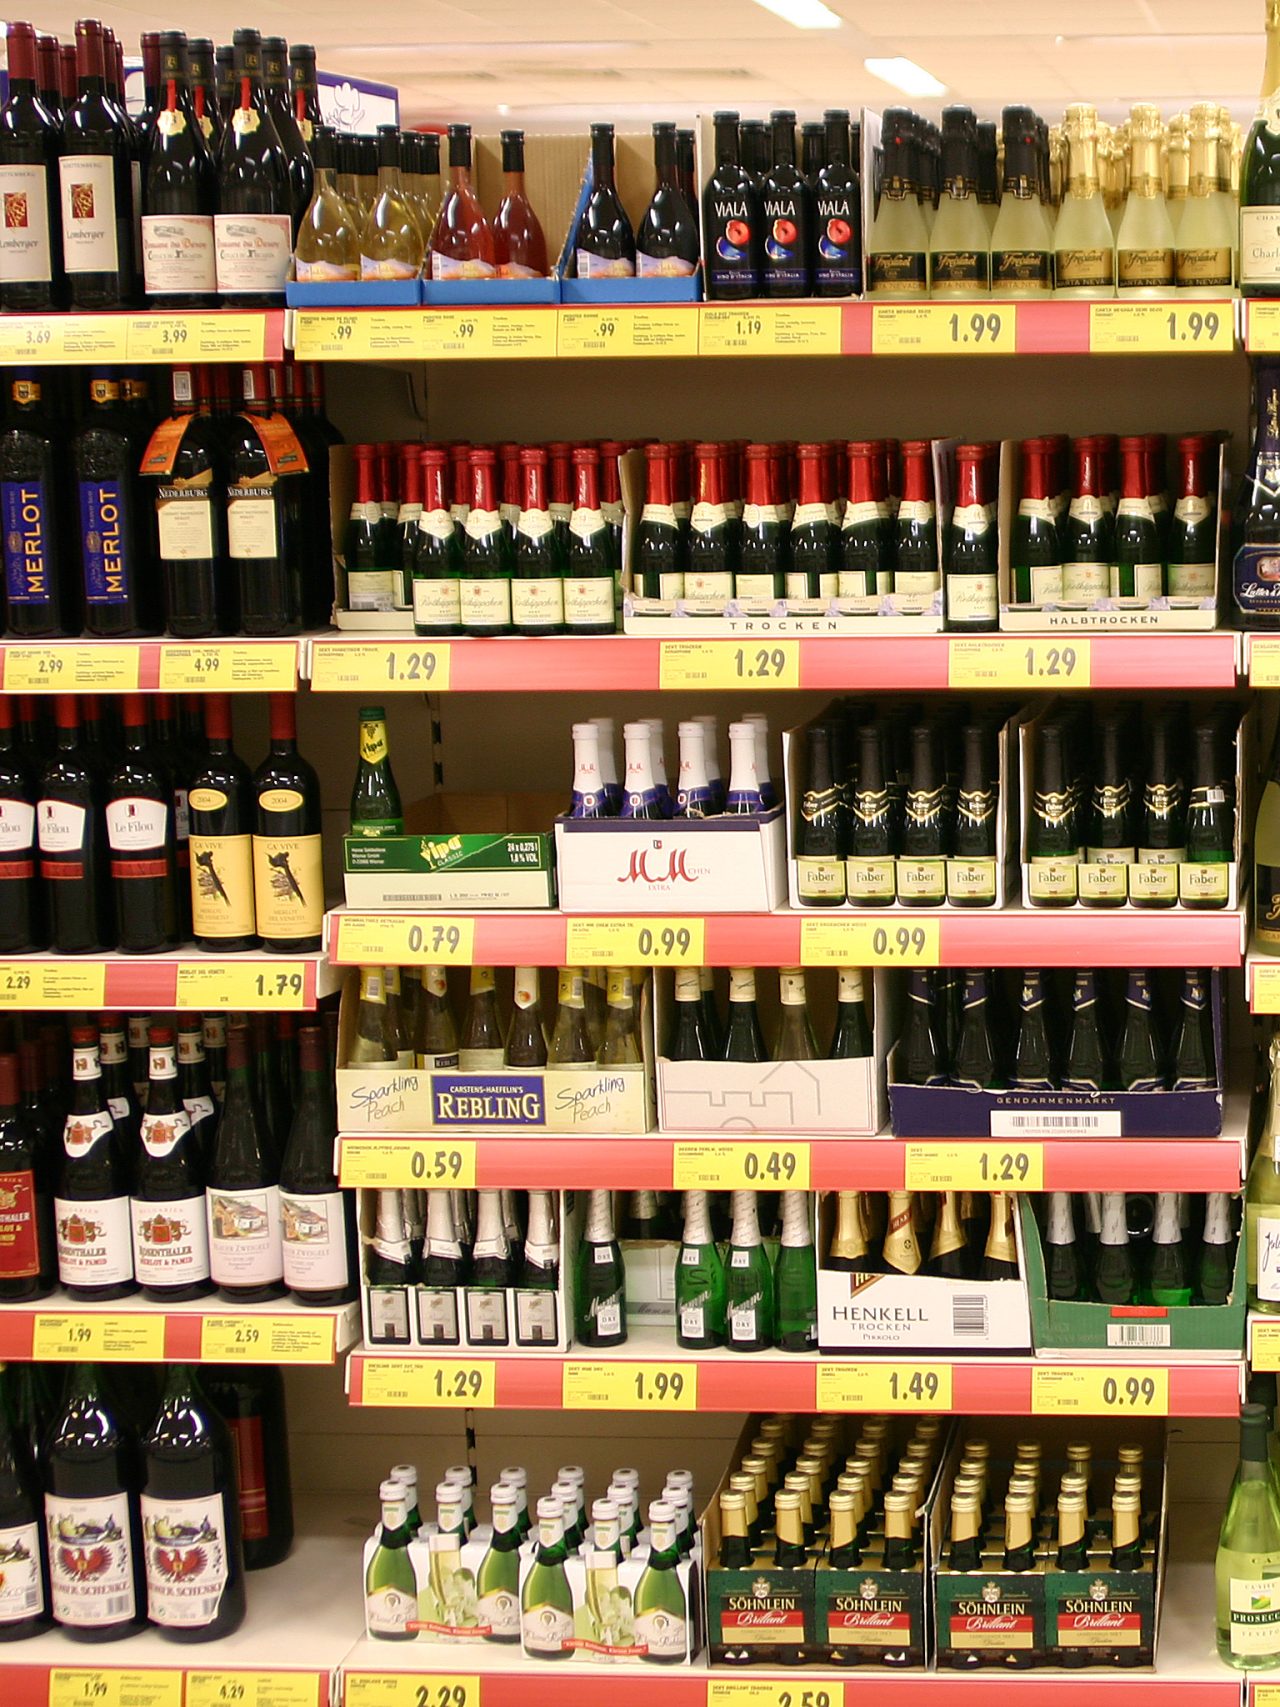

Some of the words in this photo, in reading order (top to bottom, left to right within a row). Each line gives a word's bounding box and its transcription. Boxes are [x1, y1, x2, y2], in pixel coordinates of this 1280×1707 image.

[737, 321, 761, 335] 1.19
[949, 313, 1000, 342] 1.99
[1166, 312, 1219, 340] 1.99
[26, 330, 50, 344] 3.69
[162, 330, 187, 343] 3.99
[159, 488, 208, 498] NEDERBURG
[227, 487, 272, 497] NEDERBURG
[22, 489, 45, 593] MERLOT
[100, 489, 123, 593] MERLOT
[730, 621, 837, 630] TROCKEN
[1051, 616, 1158, 625] HALBTROCKEN
[39, 660, 63, 673] 2.99
[194, 659, 219, 672] 4.99
[386, 652, 436, 680] 1.29
[734, 648, 785, 677] 1.29
[1025, 648, 1076, 676] 1.29
[115, 821, 126, 832] Le
[128, 821, 154, 832] Filou
[807, 871, 835, 882] Faber
[407, 925, 460, 954] 0.79
[639, 928, 690, 955] 0.99
[873, 927, 925, 955] 0.99
[7, 976, 30, 989] 2.29
[256, 974, 301, 996] 1.79
[350, 1075, 418, 1109] Sparkling
[555, 1075, 625, 1110] Sparkling
[366, 1096, 405, 1122] Peach
[437, 1093, 540, 1120] REBLING
[573, 1098, 611, 1123] Peach
[411, 1150, 462, 1179] 0.59
[744, 1152, 796, 1180] 0.49
[980, 1152, 1029, 1181] 1.29
[833, 1307, 929, 1321] HENKELL
[851, 1323, 911, 1331] TROCKEN
[68, 1329, 91, 1342] 1.99
[235, 1329, 259, 1343] 2.59
[434, 1370, 482, 1397] 1.29
[635, 1372, 683, 1400] 1.99
[889, 1372, 938, 1400] 1.49
[1103, 1378, 1154, 1405] 0.99
[729, 1596, 795, 1611] SÖHNLEIN
[836, 1598, 902, 1613] SÖHNLEIN
[959, 1601, 1025, 1615] SÖHNLEIN
[737, 1610, 786, 1625] Brillant
[843, 1613, 894, 1628] Brillant
[84, 1683, 107, 1696] 1.99
[220, 1685, 244, 1699] 4.29
[778, 1691, 830, 1707] 259
